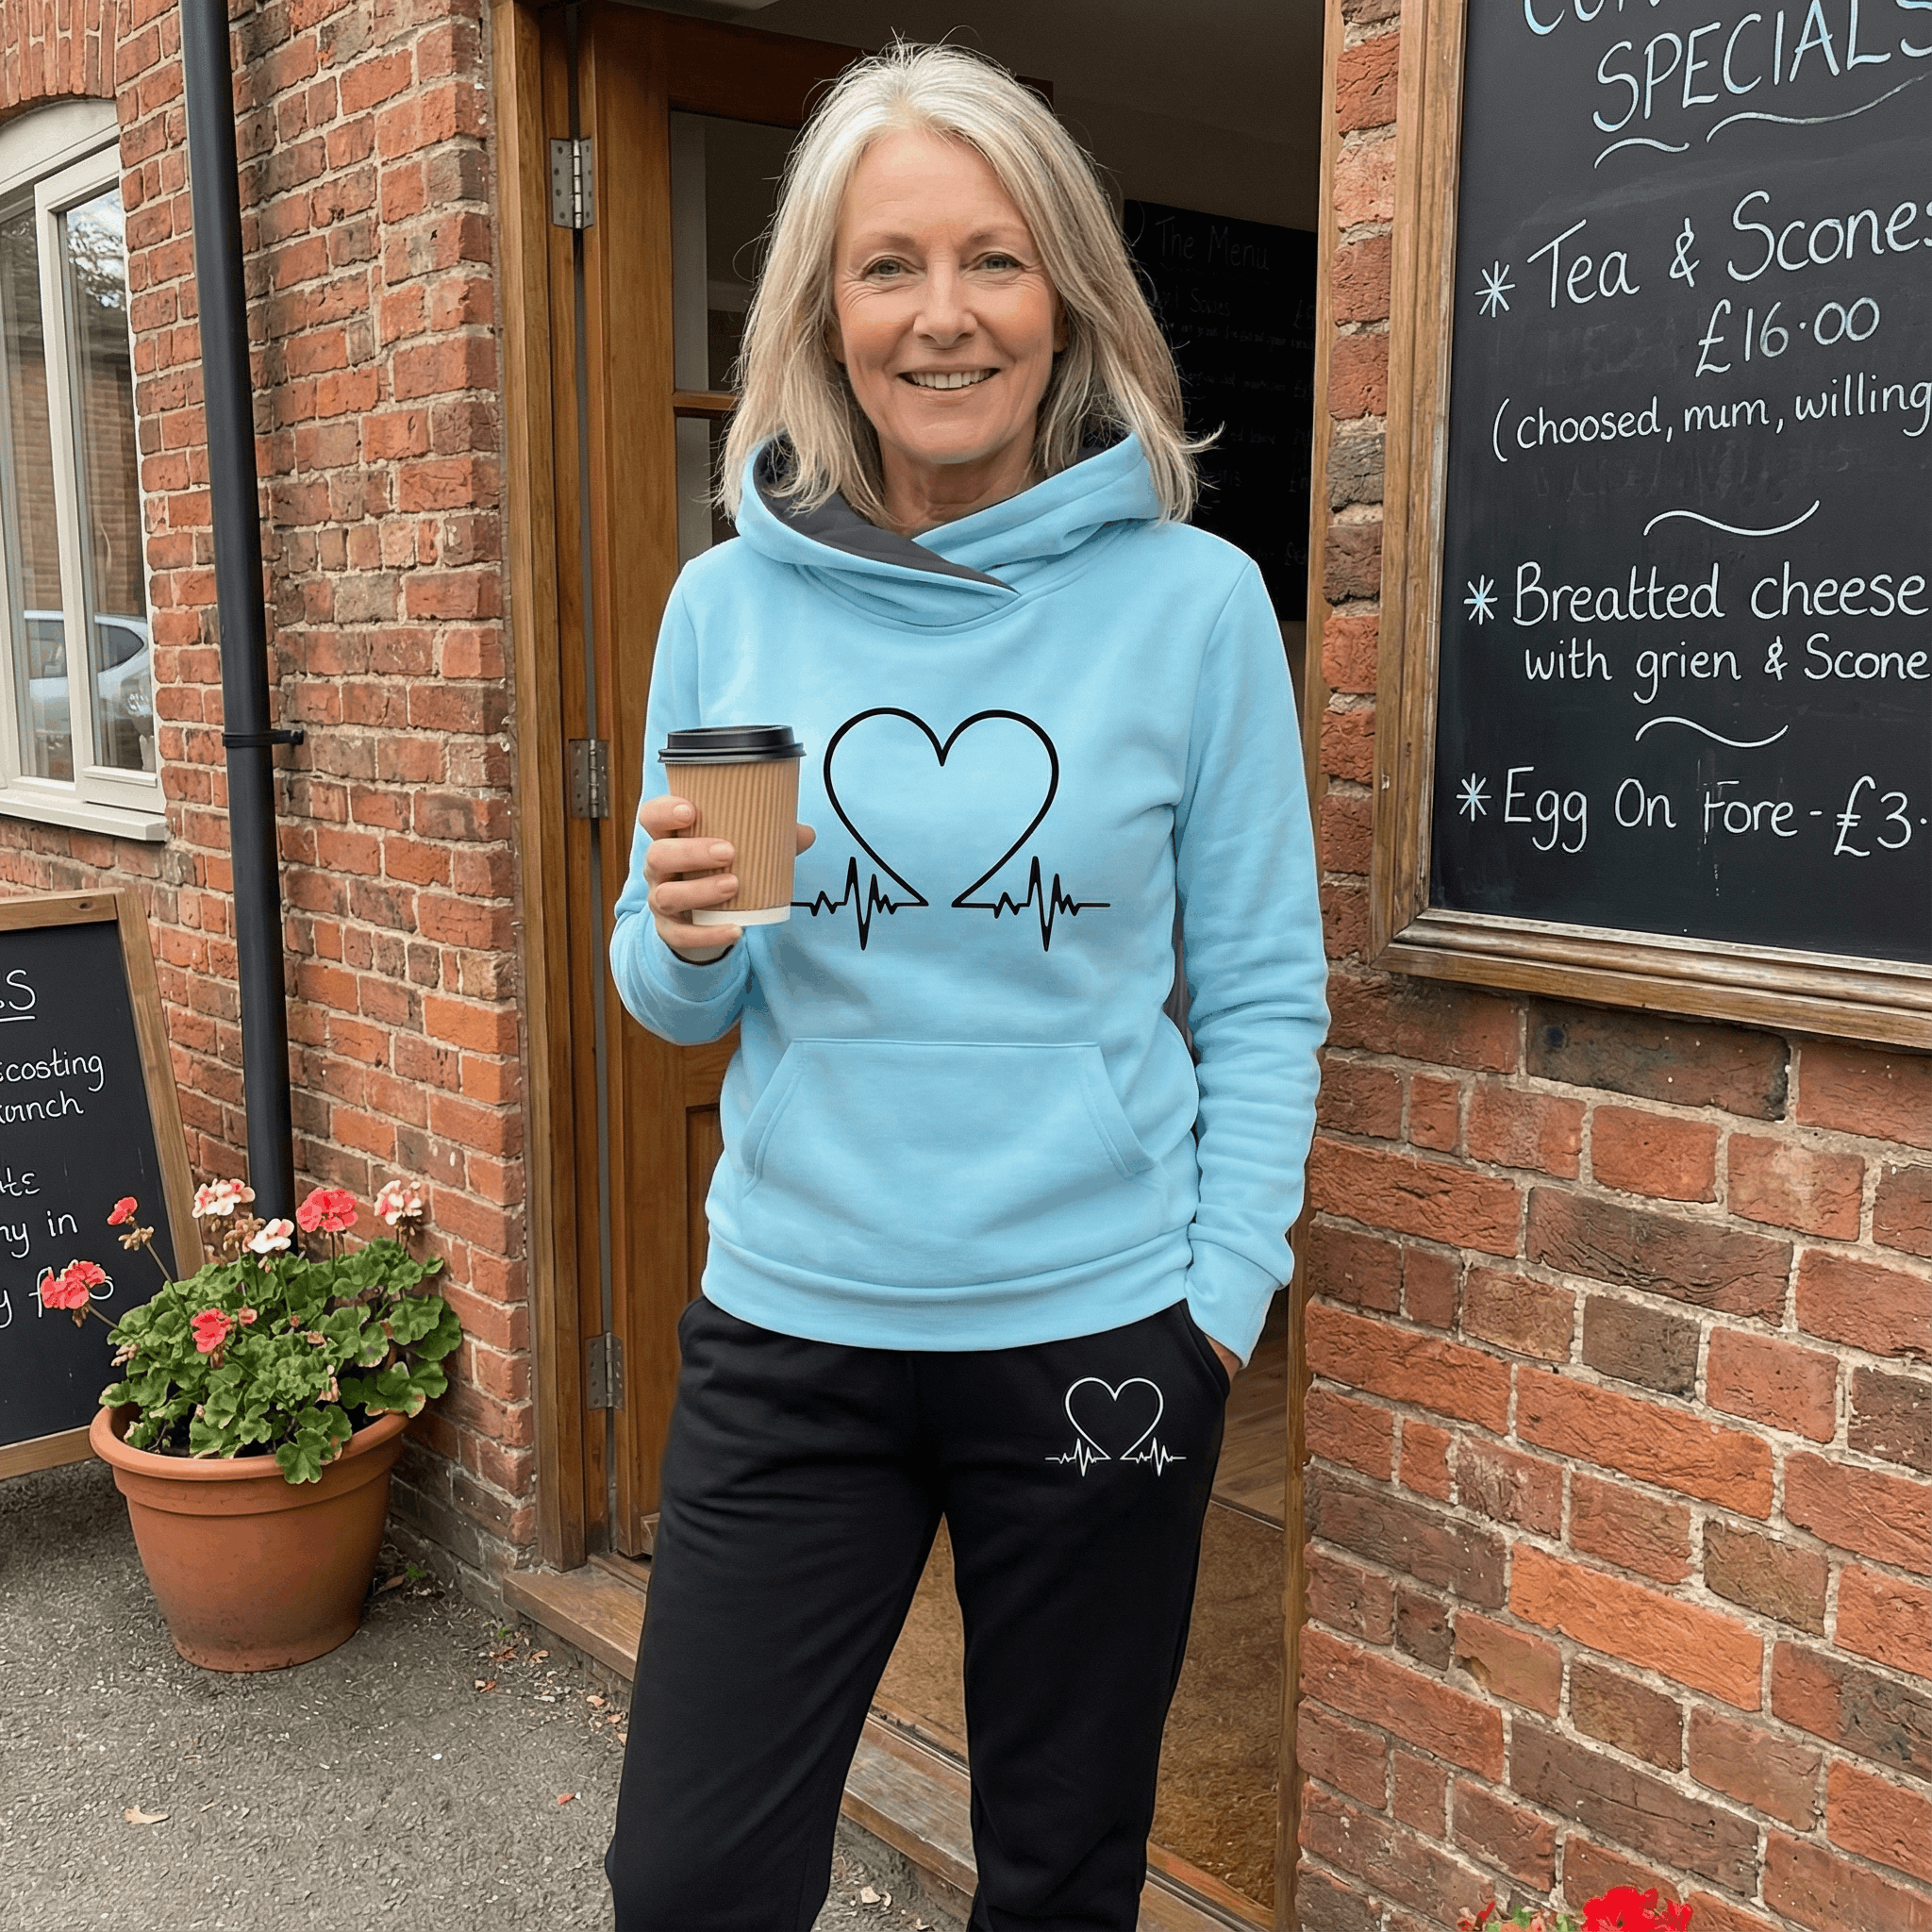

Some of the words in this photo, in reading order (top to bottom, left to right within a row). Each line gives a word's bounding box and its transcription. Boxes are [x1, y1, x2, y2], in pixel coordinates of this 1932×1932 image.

[1156, 215, 1195, 259] The
[1208, 225, 1270, 271] Menu
[1526, 219, 1641, 308] Tea
[1669, 217, 1700, 288] &
[1795, 372, 1932, 437] willing
[1512, 561, 1725, 626] Breatted
[1751, 560, 1929, 620] cheese
[1525, 637, 1613, 681] with
[1633, 641, 1741, 705] grien
[1764, 635, 1789, 681] &
[1804, 632, 1931, 680] Scone
[1504, 766, 1587, 854] Egg
[1614, 778, 1677, 828] On
[0, 969, 36, 1012] S
[47, 1210, 78, 1237] in
